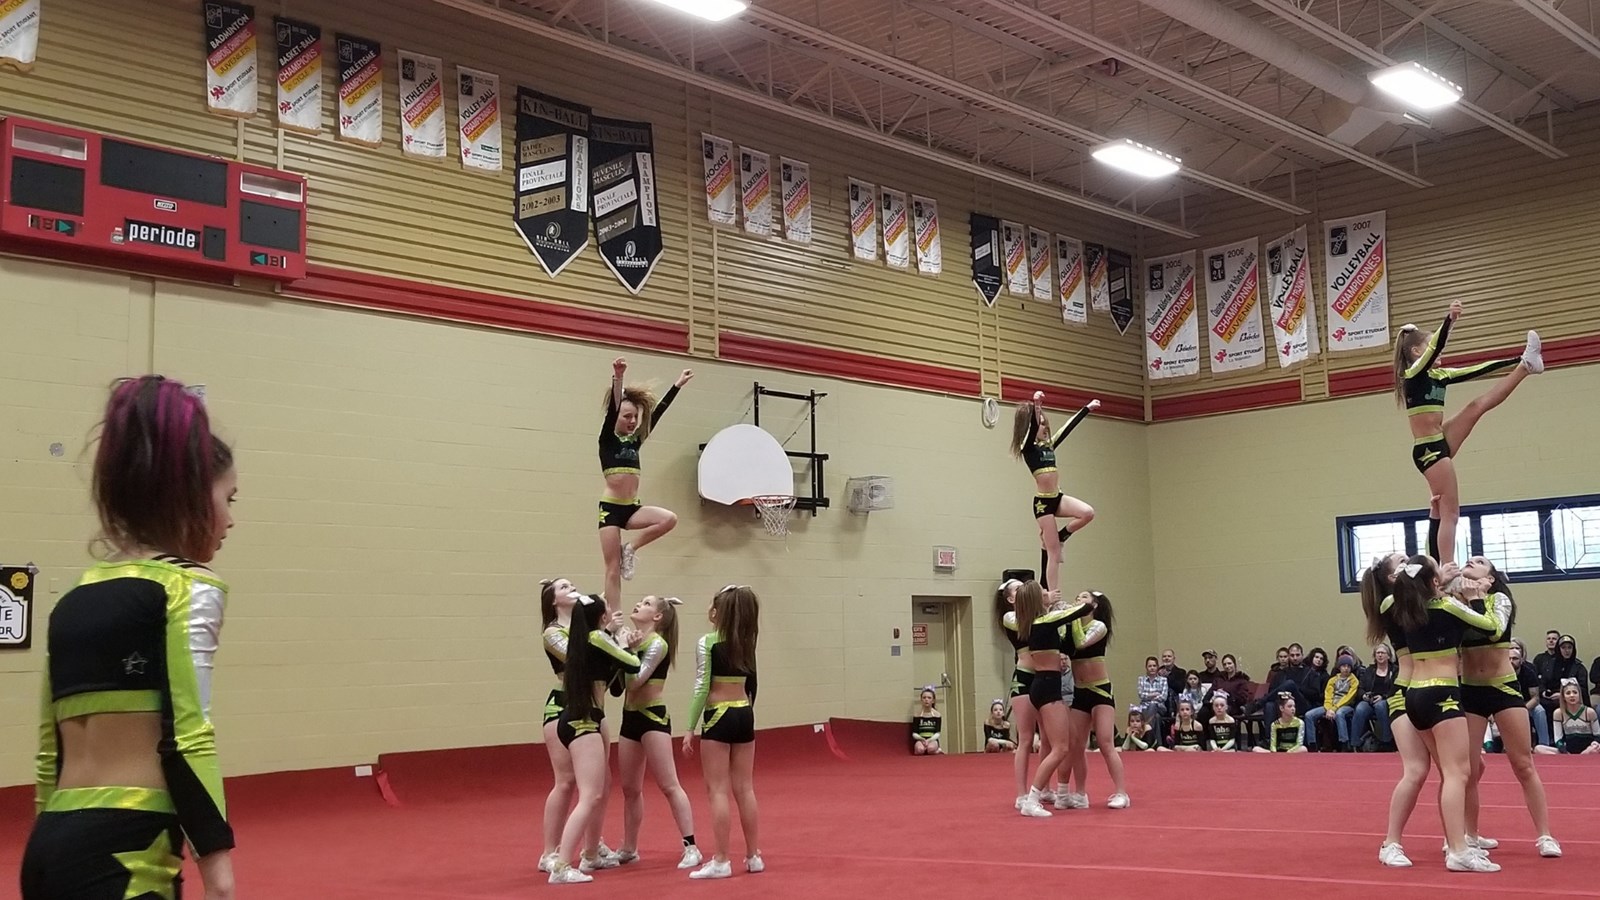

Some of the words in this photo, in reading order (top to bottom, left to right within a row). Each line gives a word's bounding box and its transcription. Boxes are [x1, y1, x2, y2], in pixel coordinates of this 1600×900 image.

[210, 13, 250, 49] BADMINTON
[279, 34, 317, 66] BASKET-BALL
[279, 48, 318, 82] CHAMPIONS
[342, 50, 377, 82] ATHLÉTISME
[341, 63, 378, 97] CHAMPIONNES
[403, 72, 438, 107] ATHLÉTISME
[461, 88, 495, 120] VOLLEY-BALL
[523, 98, 587, 130] KIN-BALL
[522, 169, 544, 179] FINALE
[522, 171, 564, 186] PROVINCIALE
[592, 161, 624, 178] JUVENILE
[593, 167, 626, 184] MASCULIN
[705, 152, 729, 181] HOCKEY
[521, 194, 561, 211] 2002-2003
[597, 190, 634, 212] PROVINCIALE
[642, 154, 654, 224] CHAMPIONS
[129, 223, 196, 248] periode
[1353, 221, 1371, 231] 2007
[1331, 232, 1380, 291] VOLLEYBALL
[1273, 247, 1306, 309] VOLLEYBALL
[1337, 254, 1381, 310] CHAMPIONNES
[1347, 270, 1383, 317] JUVENILES
[1153, 288, 1193, 341] CHAMPIONNE
[1216, 278, 1257, 335] CHAMPIONNE
[1227, 296, 1257, 340] JUVENILE
[1352, 297, 1373, 323] Division
[1161, 304, 1194, 348] CADETTE
